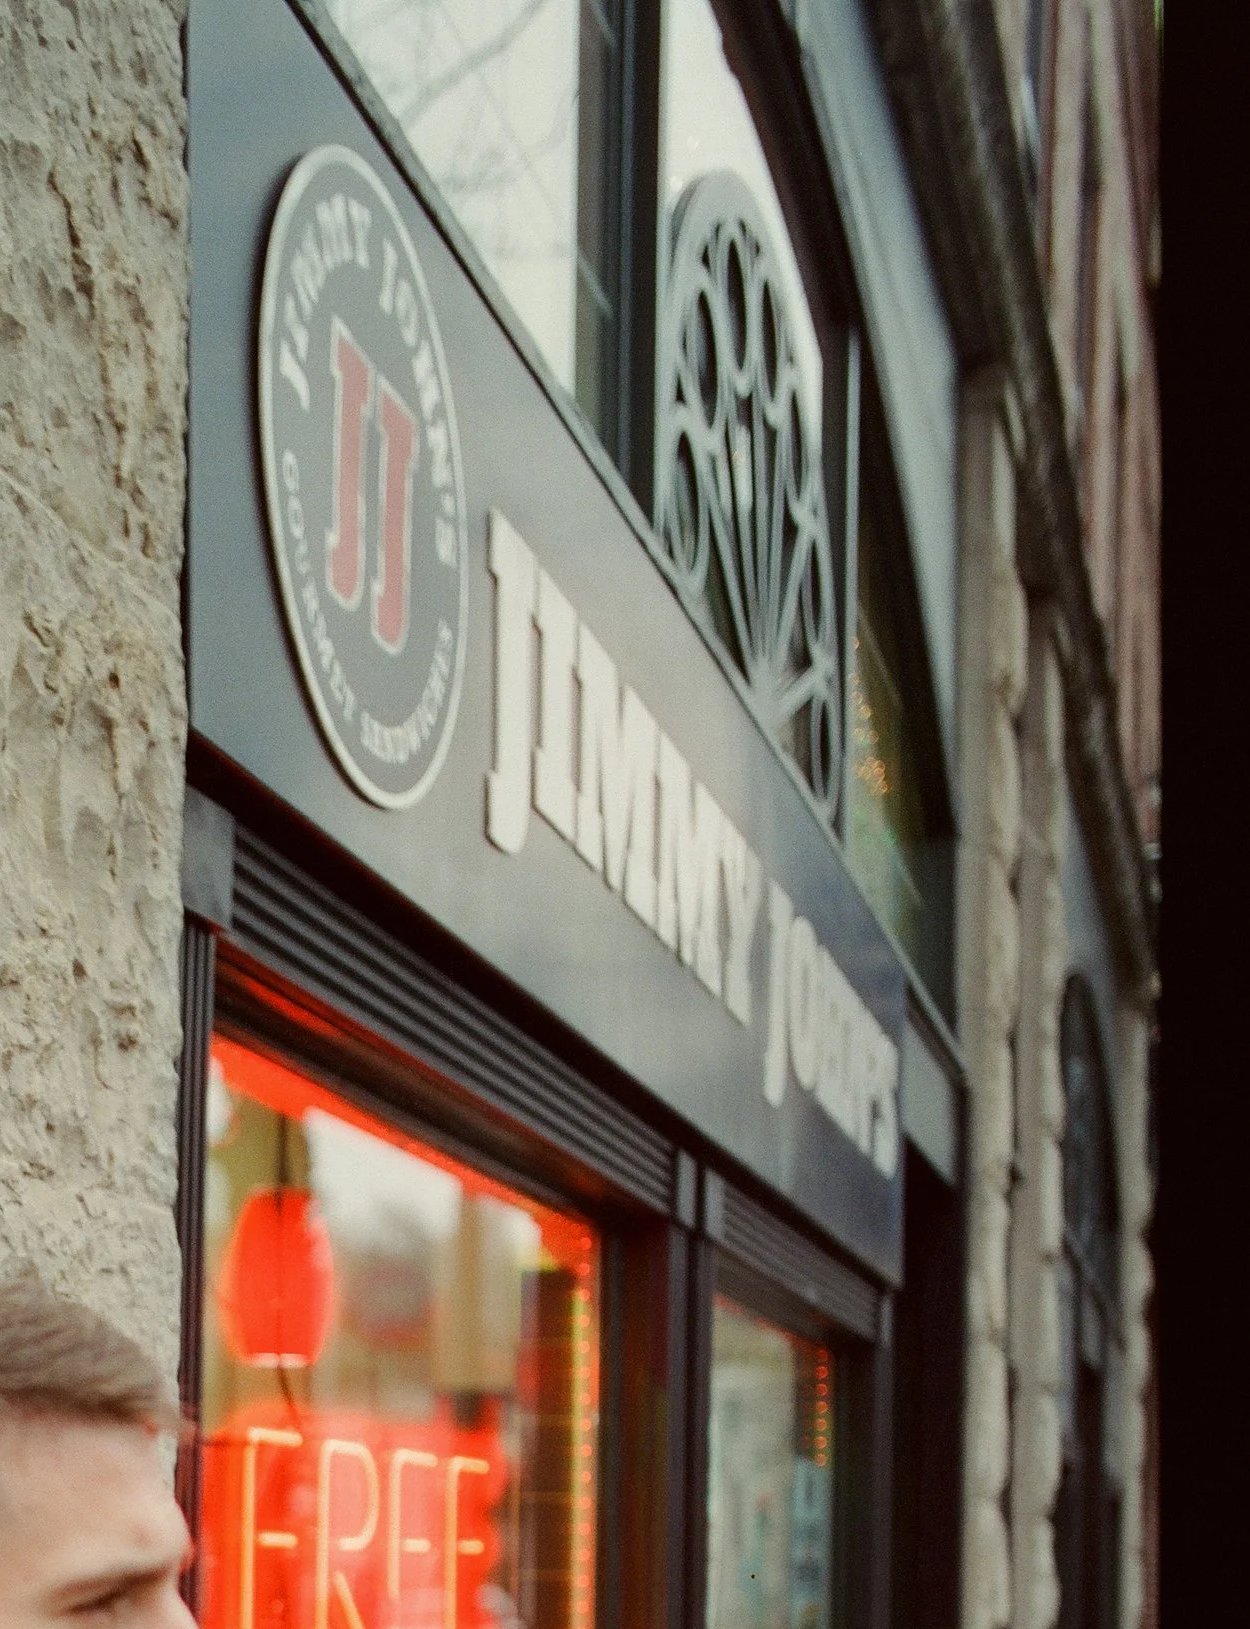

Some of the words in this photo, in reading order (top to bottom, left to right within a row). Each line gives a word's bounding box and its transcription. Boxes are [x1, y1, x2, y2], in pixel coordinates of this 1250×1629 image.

[279, 193, 372, 412] JIMMY
[378, 238, 457, 568] JOHN'S
[485, 507, 763, 1028] JIMMY
